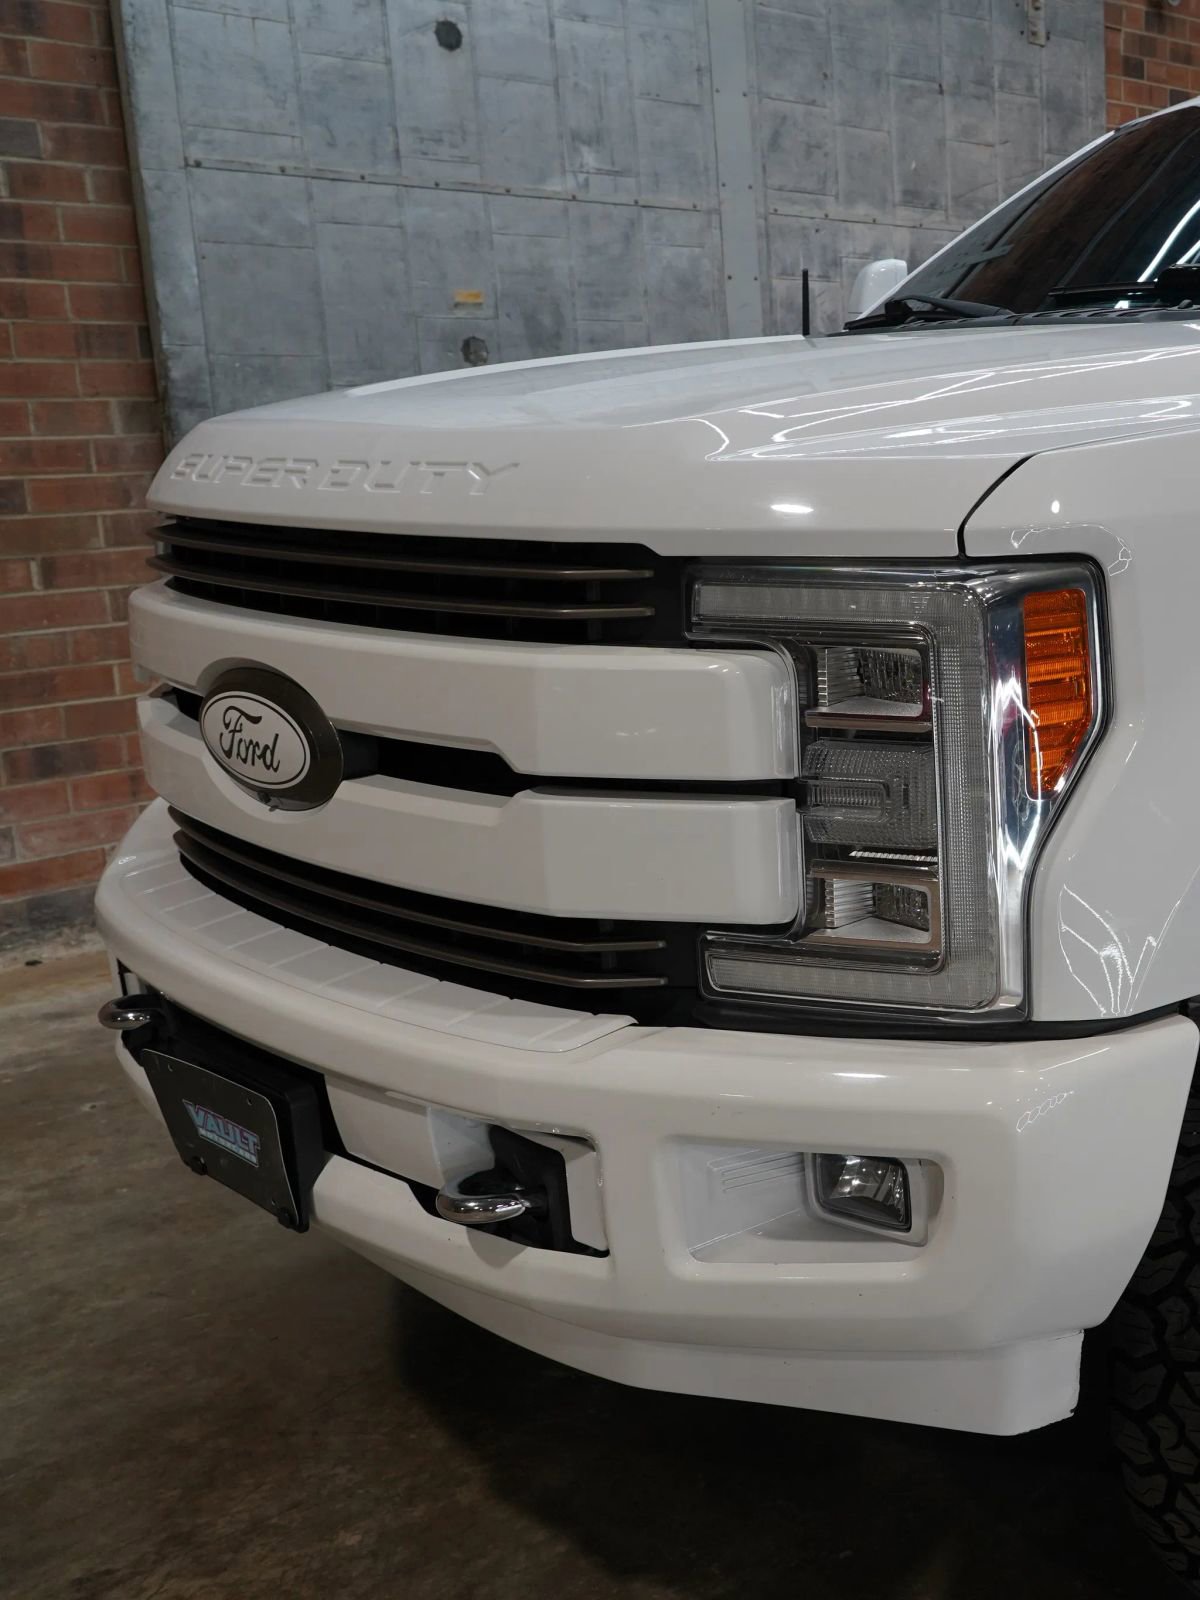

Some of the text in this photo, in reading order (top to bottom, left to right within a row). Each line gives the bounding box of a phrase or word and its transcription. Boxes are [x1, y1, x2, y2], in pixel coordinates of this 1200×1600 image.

[170, 453, 521, 496] SUPER DUTY
[219, 705, 281, 773] Ford
[182, 1099, 260, 1157] VAULT
